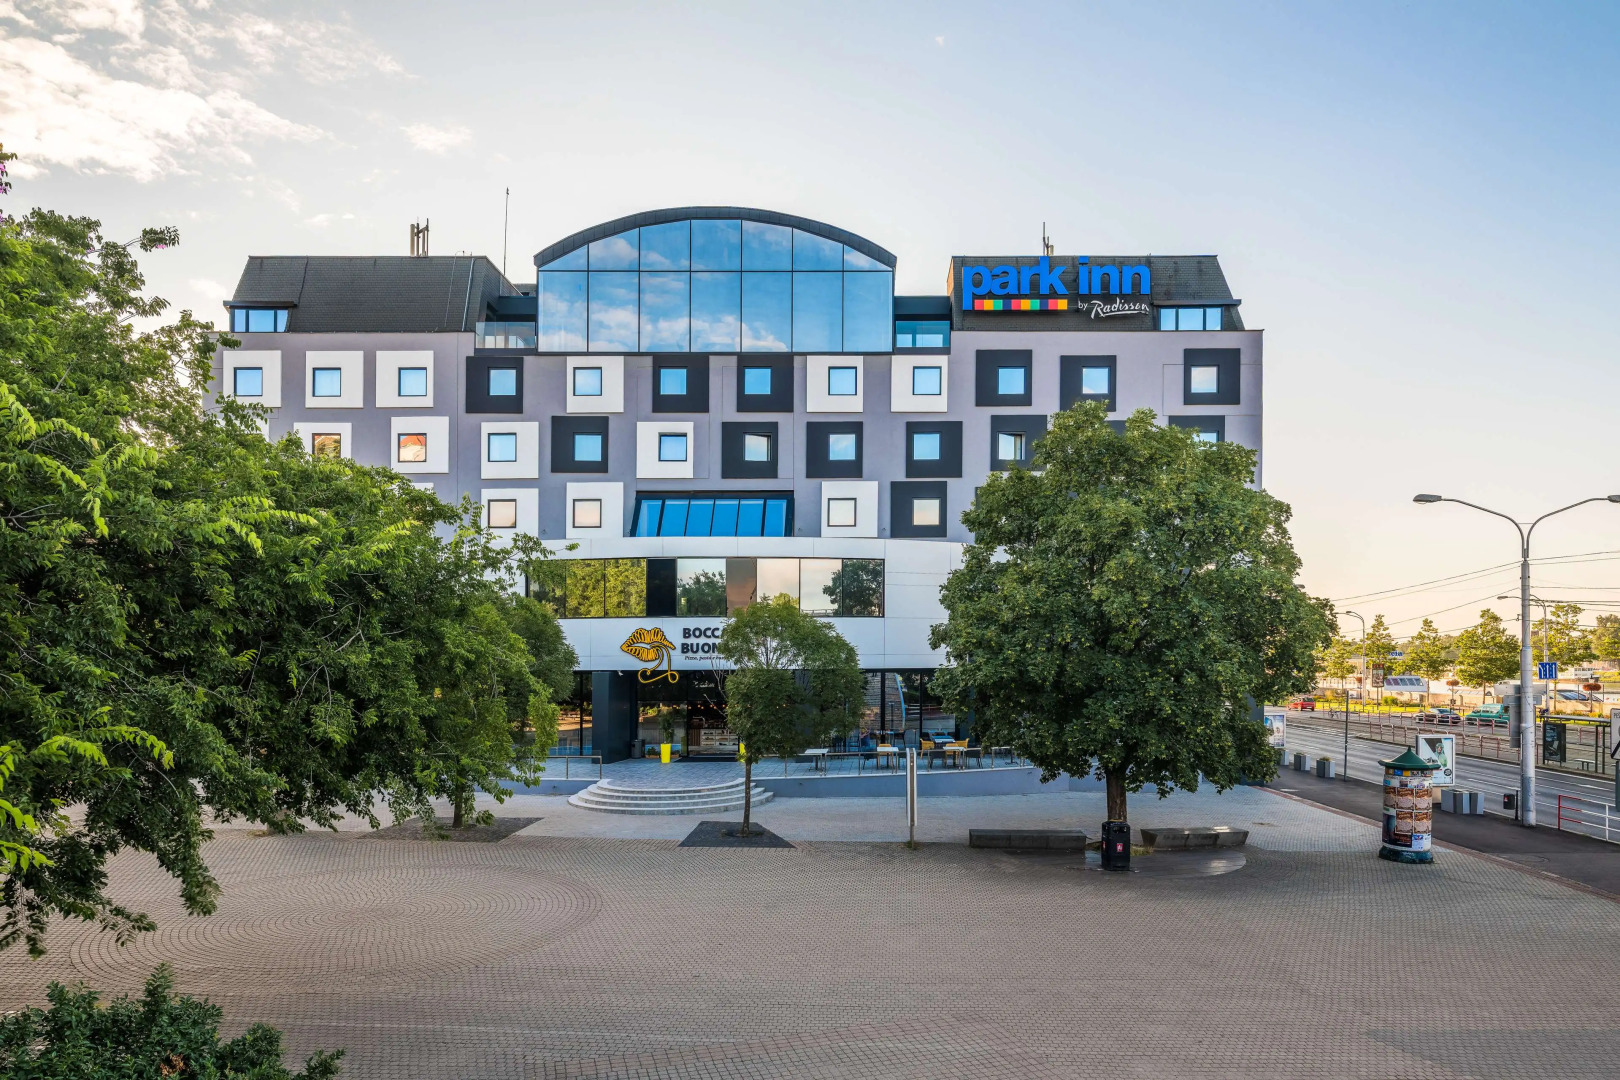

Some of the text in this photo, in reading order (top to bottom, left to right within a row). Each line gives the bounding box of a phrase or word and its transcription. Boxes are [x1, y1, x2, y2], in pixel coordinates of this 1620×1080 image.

[963, 256, 1150, 311] park inn
[1078, 297, 1149, 319] by Radisson
[683, 627, 725, 639] BOCC
